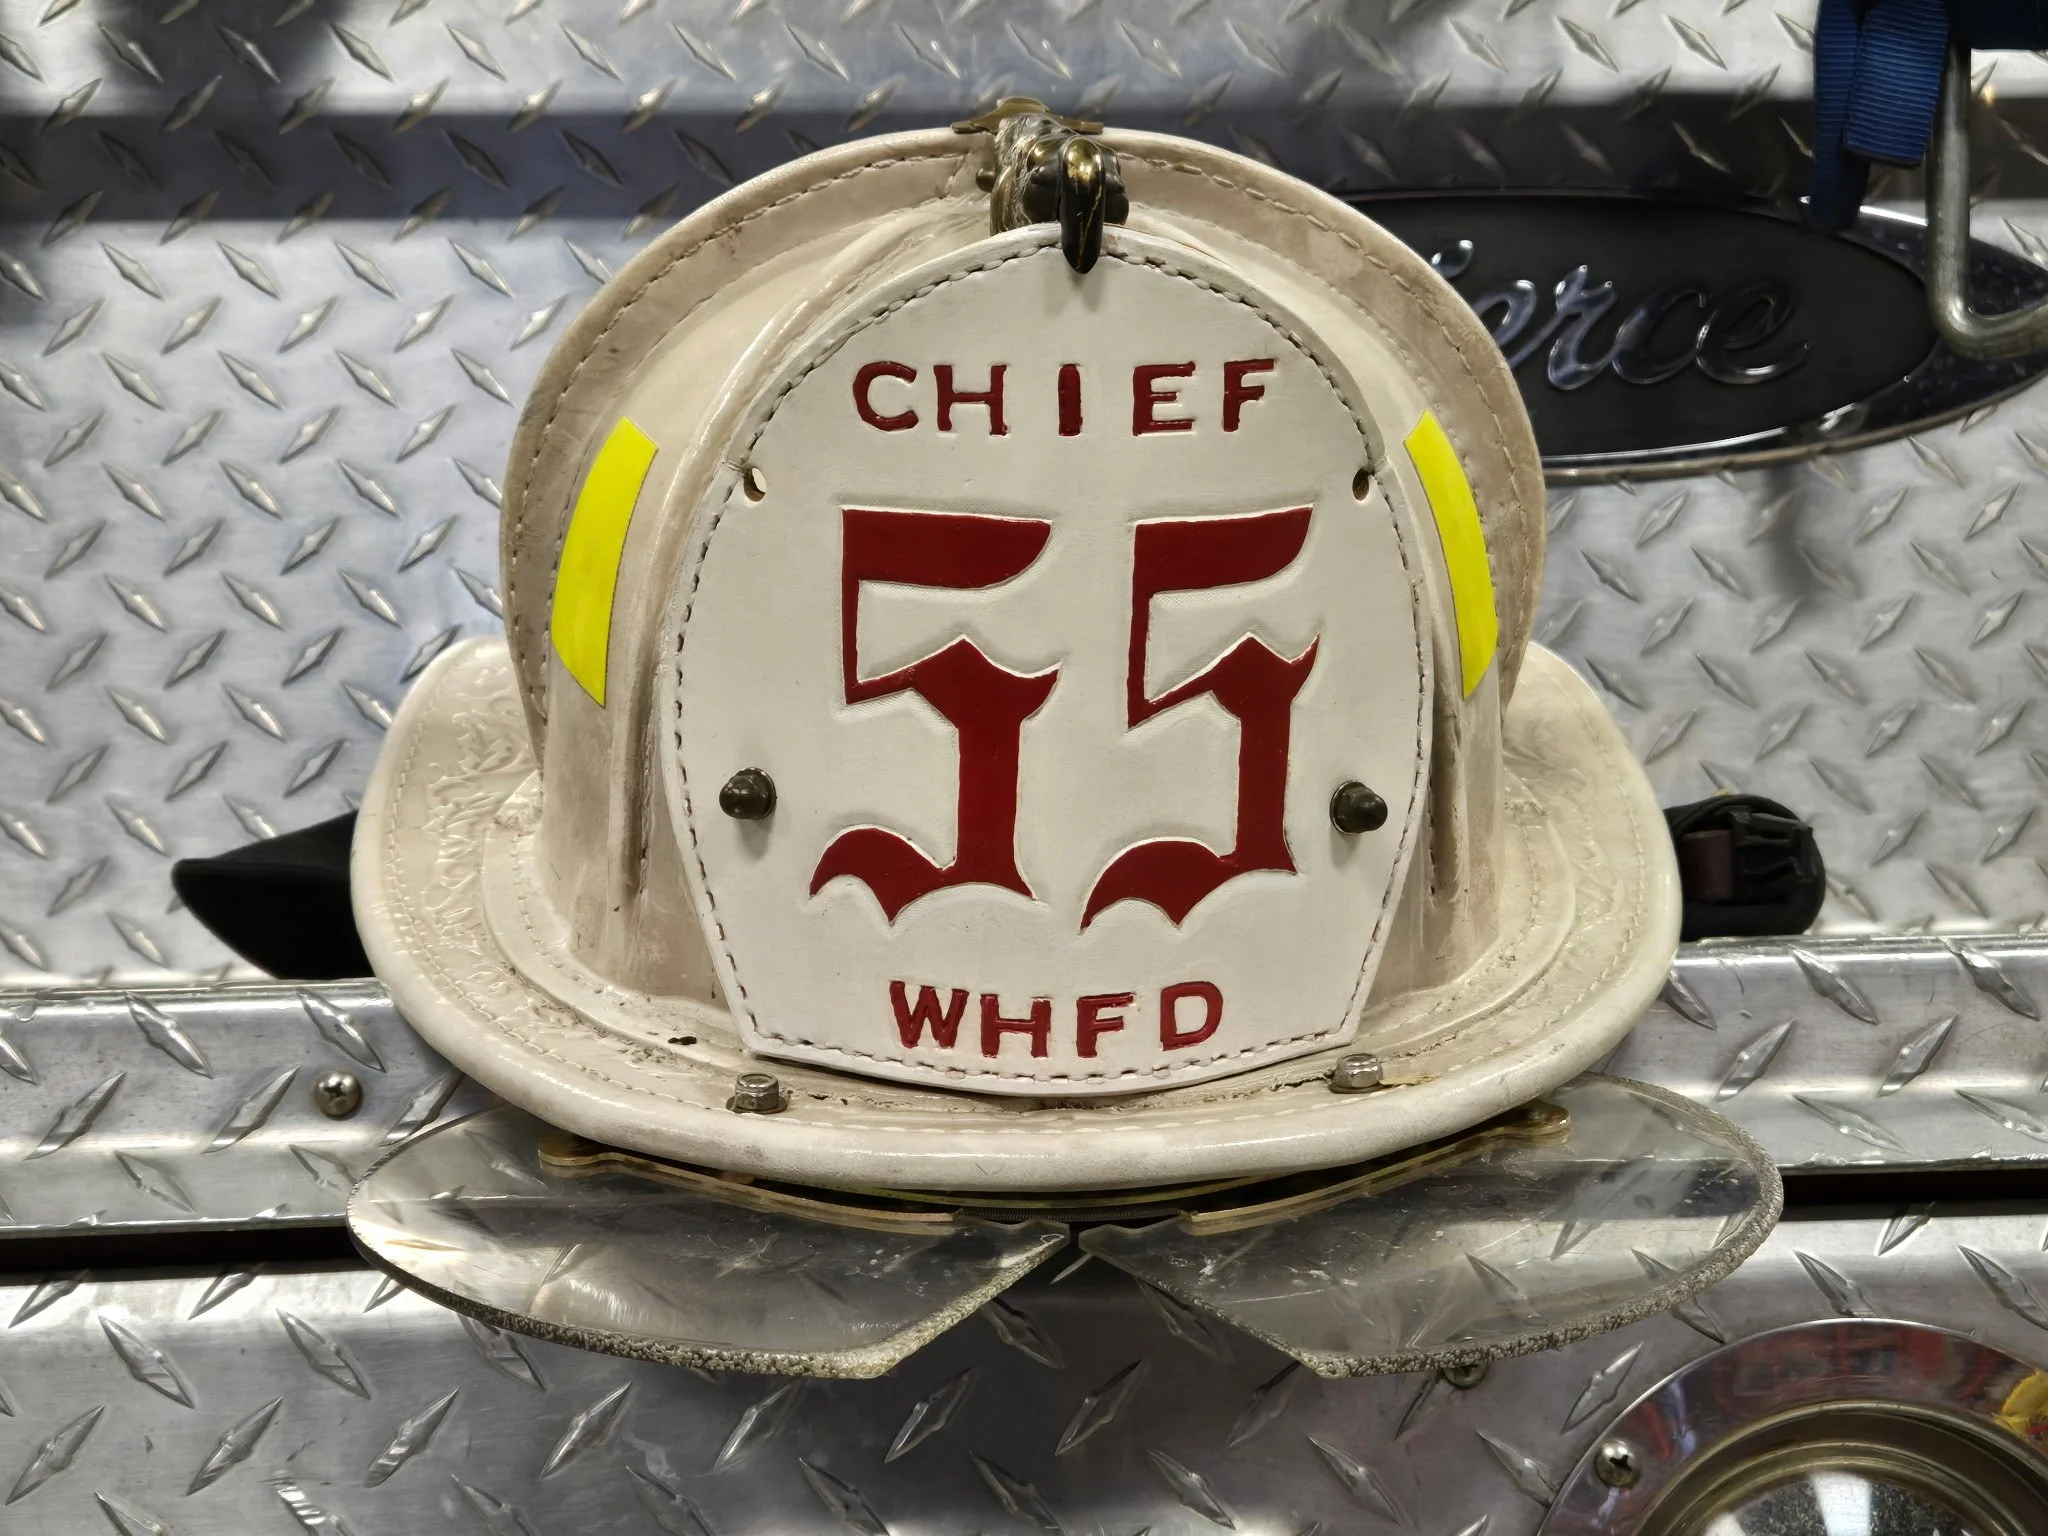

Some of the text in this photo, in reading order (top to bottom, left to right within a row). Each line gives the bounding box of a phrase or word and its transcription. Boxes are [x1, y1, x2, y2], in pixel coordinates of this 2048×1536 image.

[1431, 238, 1814, 391] erce
[854, 359, 1275, 438] CHIEF
[811, 504, 1320, 929] 55
[889, 980, 1223, 1059] WHFD
